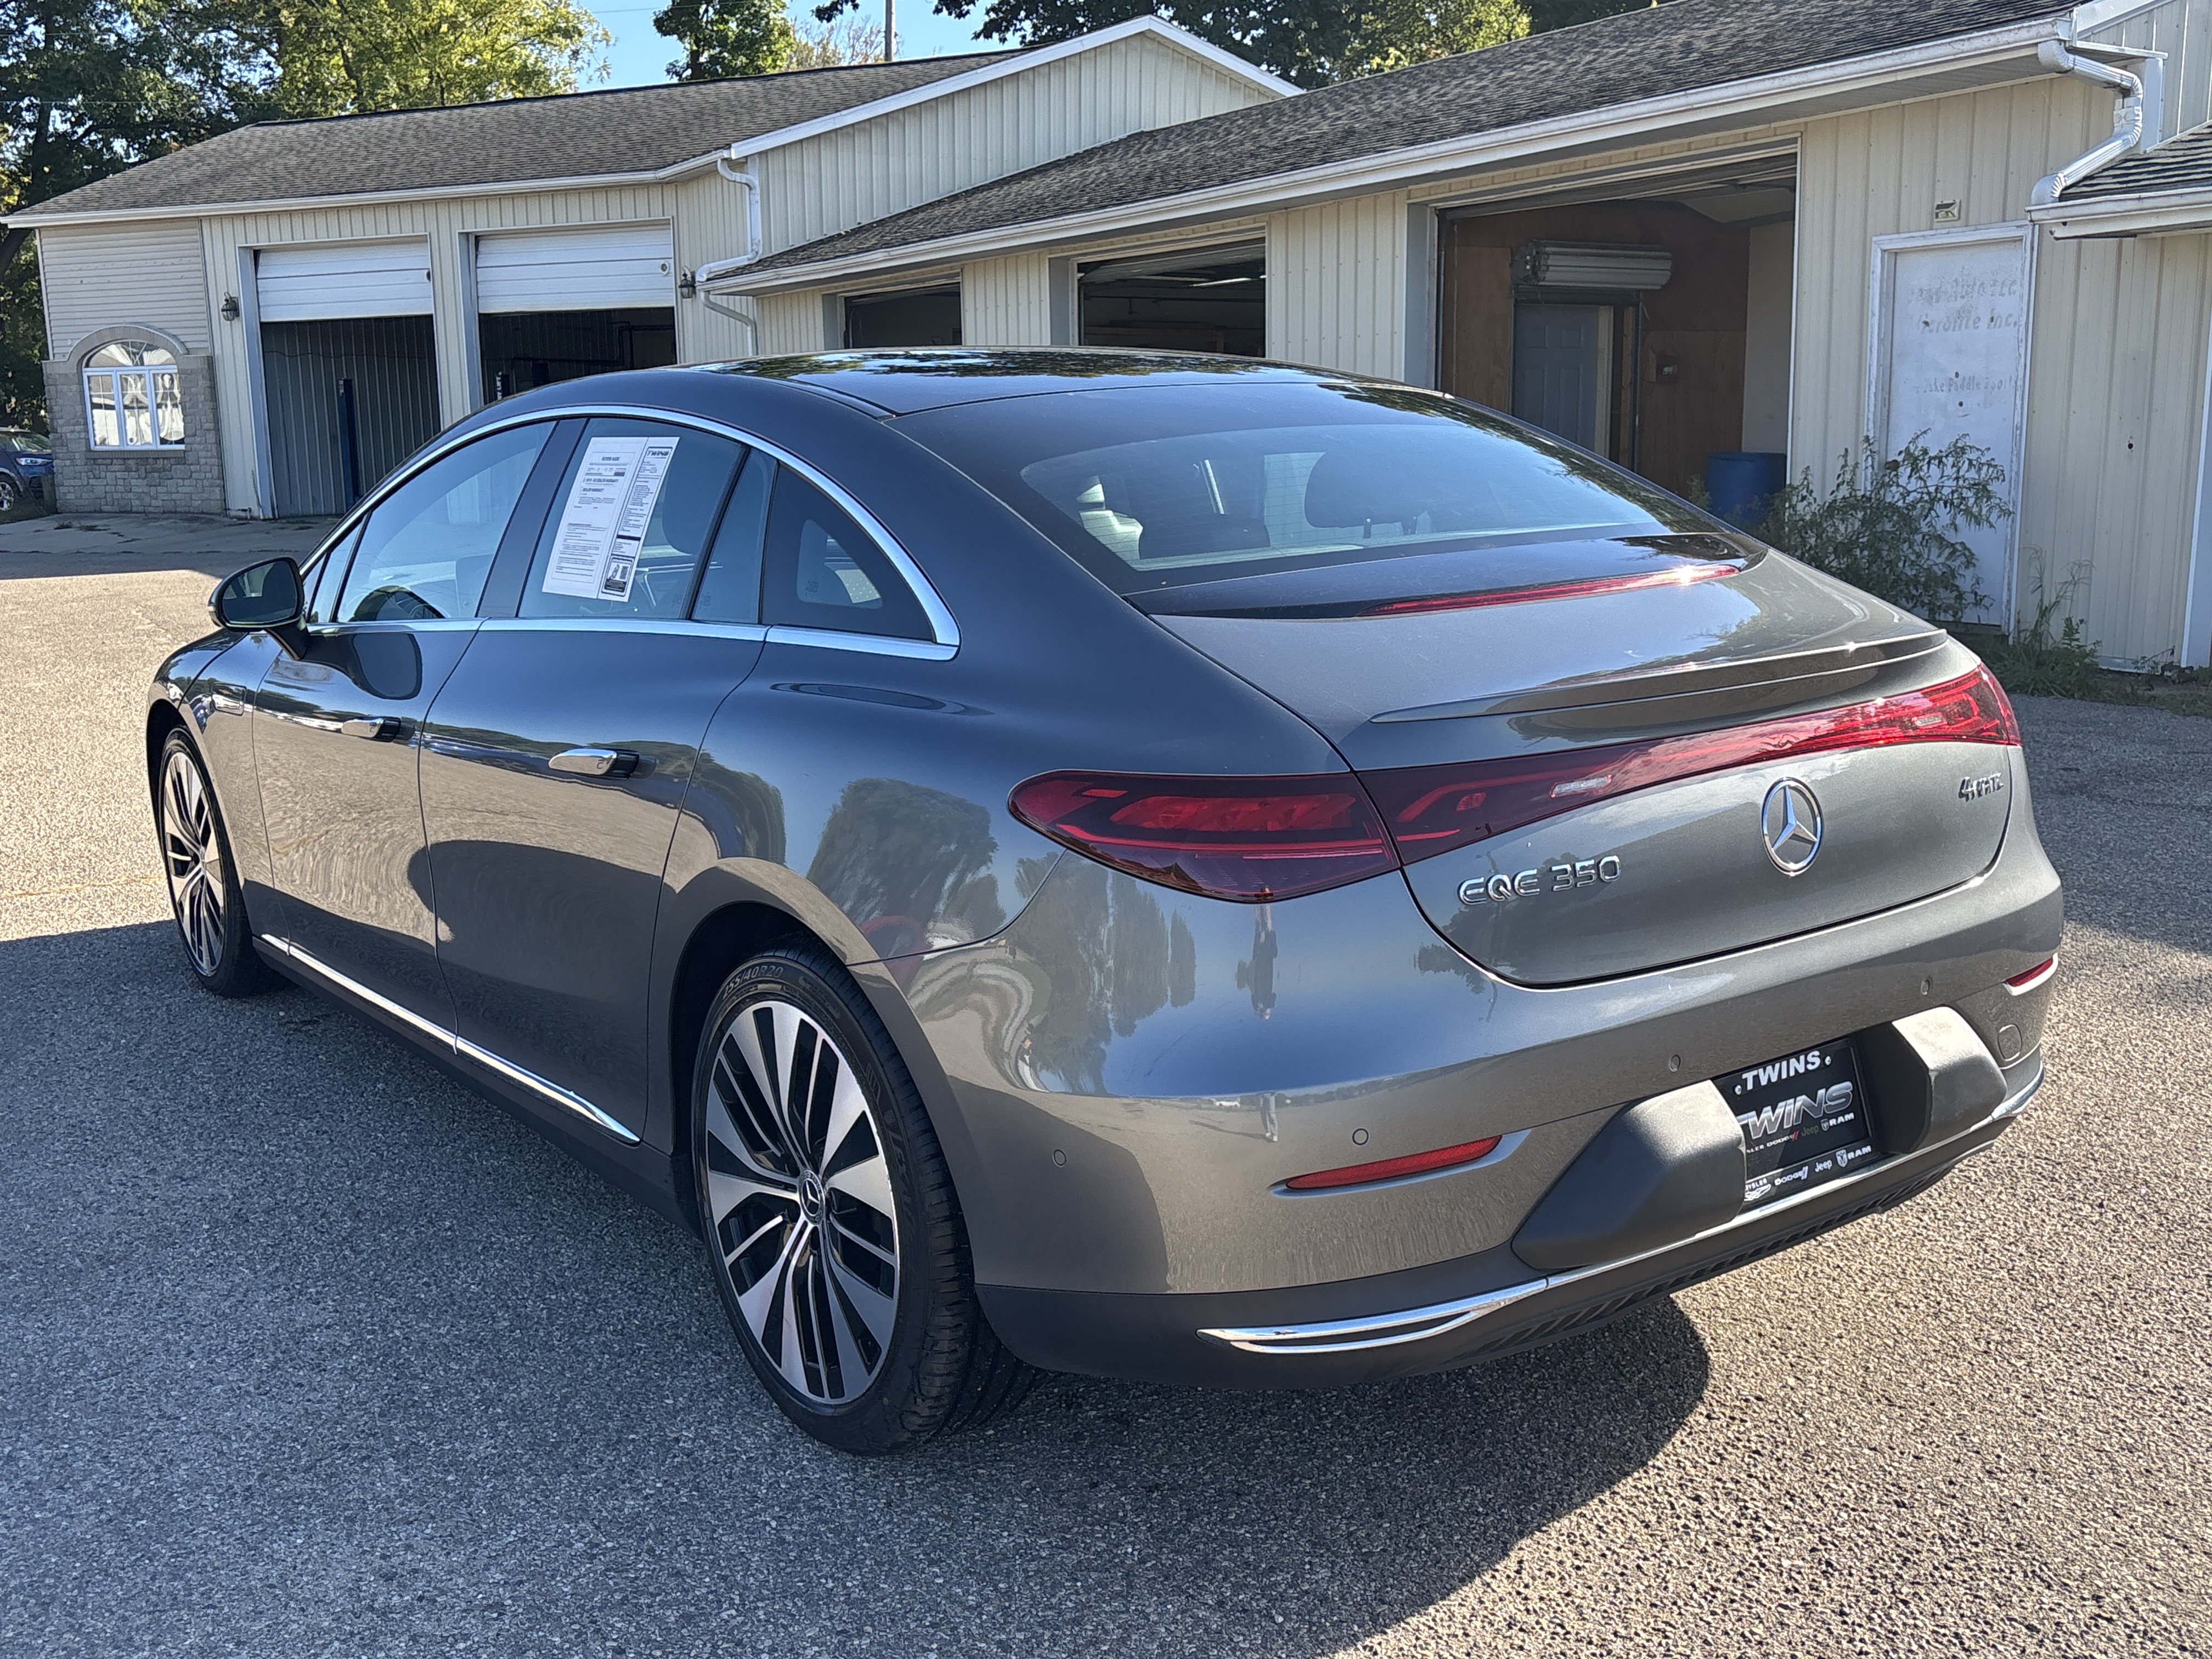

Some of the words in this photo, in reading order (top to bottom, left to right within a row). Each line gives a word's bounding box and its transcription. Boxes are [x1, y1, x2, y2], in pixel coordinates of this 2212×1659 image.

[1457, 868, 1541, 906] EQE
[1548, 855, 1622, 892] 350
[722, 965, 784, 1000] 255/40R20
[1741, 1050, 1821, 1091] TWINS
[1801, 1125, 1819, 1137] Jeep
[1829, 1112, 1855, 1126] RAM
[1774, 1170, 1803, 1186] DODGE
[1815, 1159, 1832, 1172] Jeep
[1847, 1144, 1872, 1160] RAM
